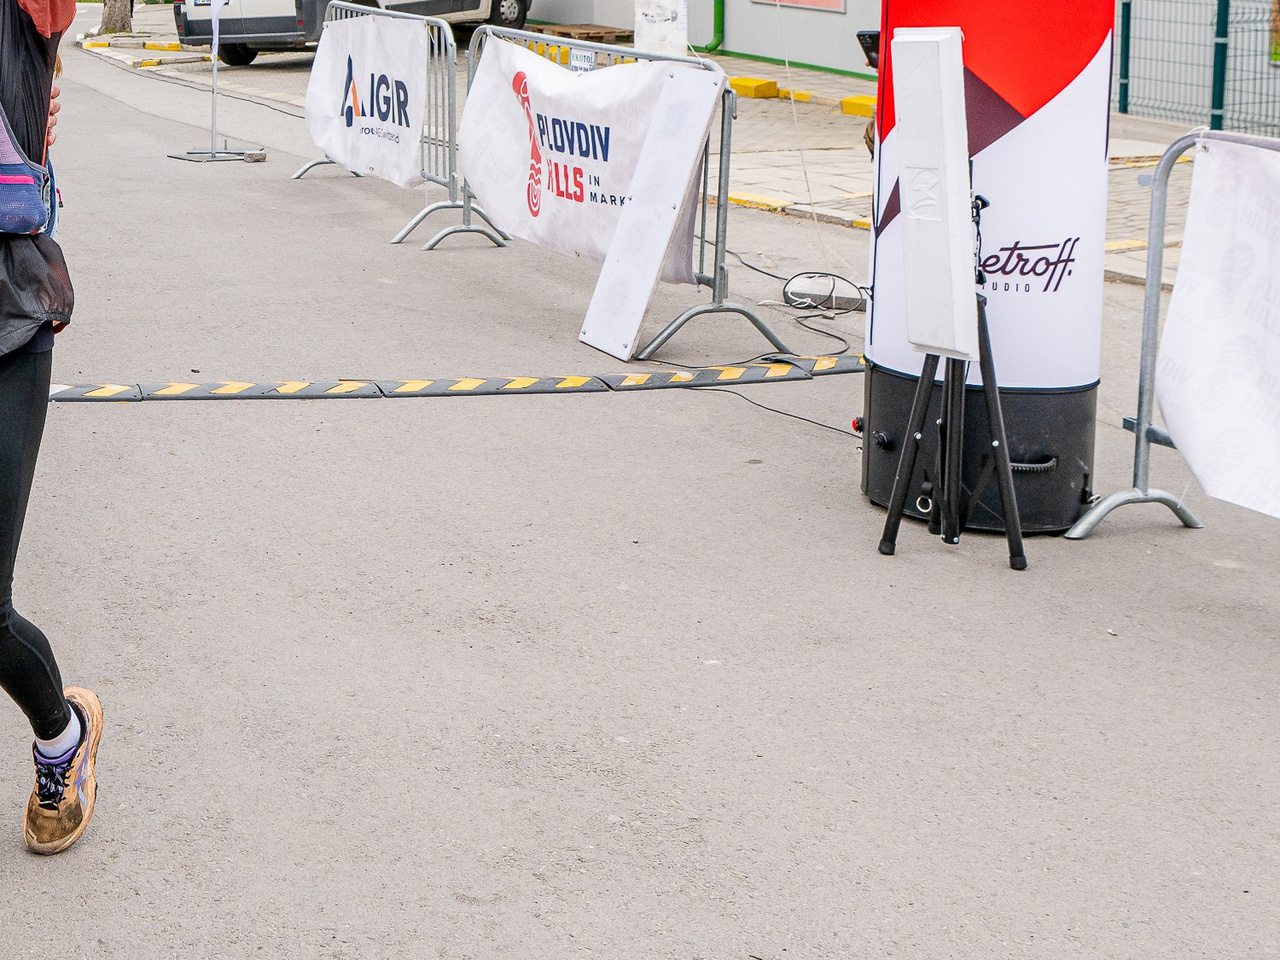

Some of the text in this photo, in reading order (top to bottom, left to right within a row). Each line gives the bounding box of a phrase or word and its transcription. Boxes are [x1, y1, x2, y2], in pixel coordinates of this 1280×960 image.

[536, 113, 610, 162] PLOVDIV
[546, 159, 585, 203] HLLS
[588, 174, 600, 187] IN
[589, 191, 626, 206] MARK
[979, 237, 1081, 293] etroff.
[982, 282, 1031, 293] UDIO
